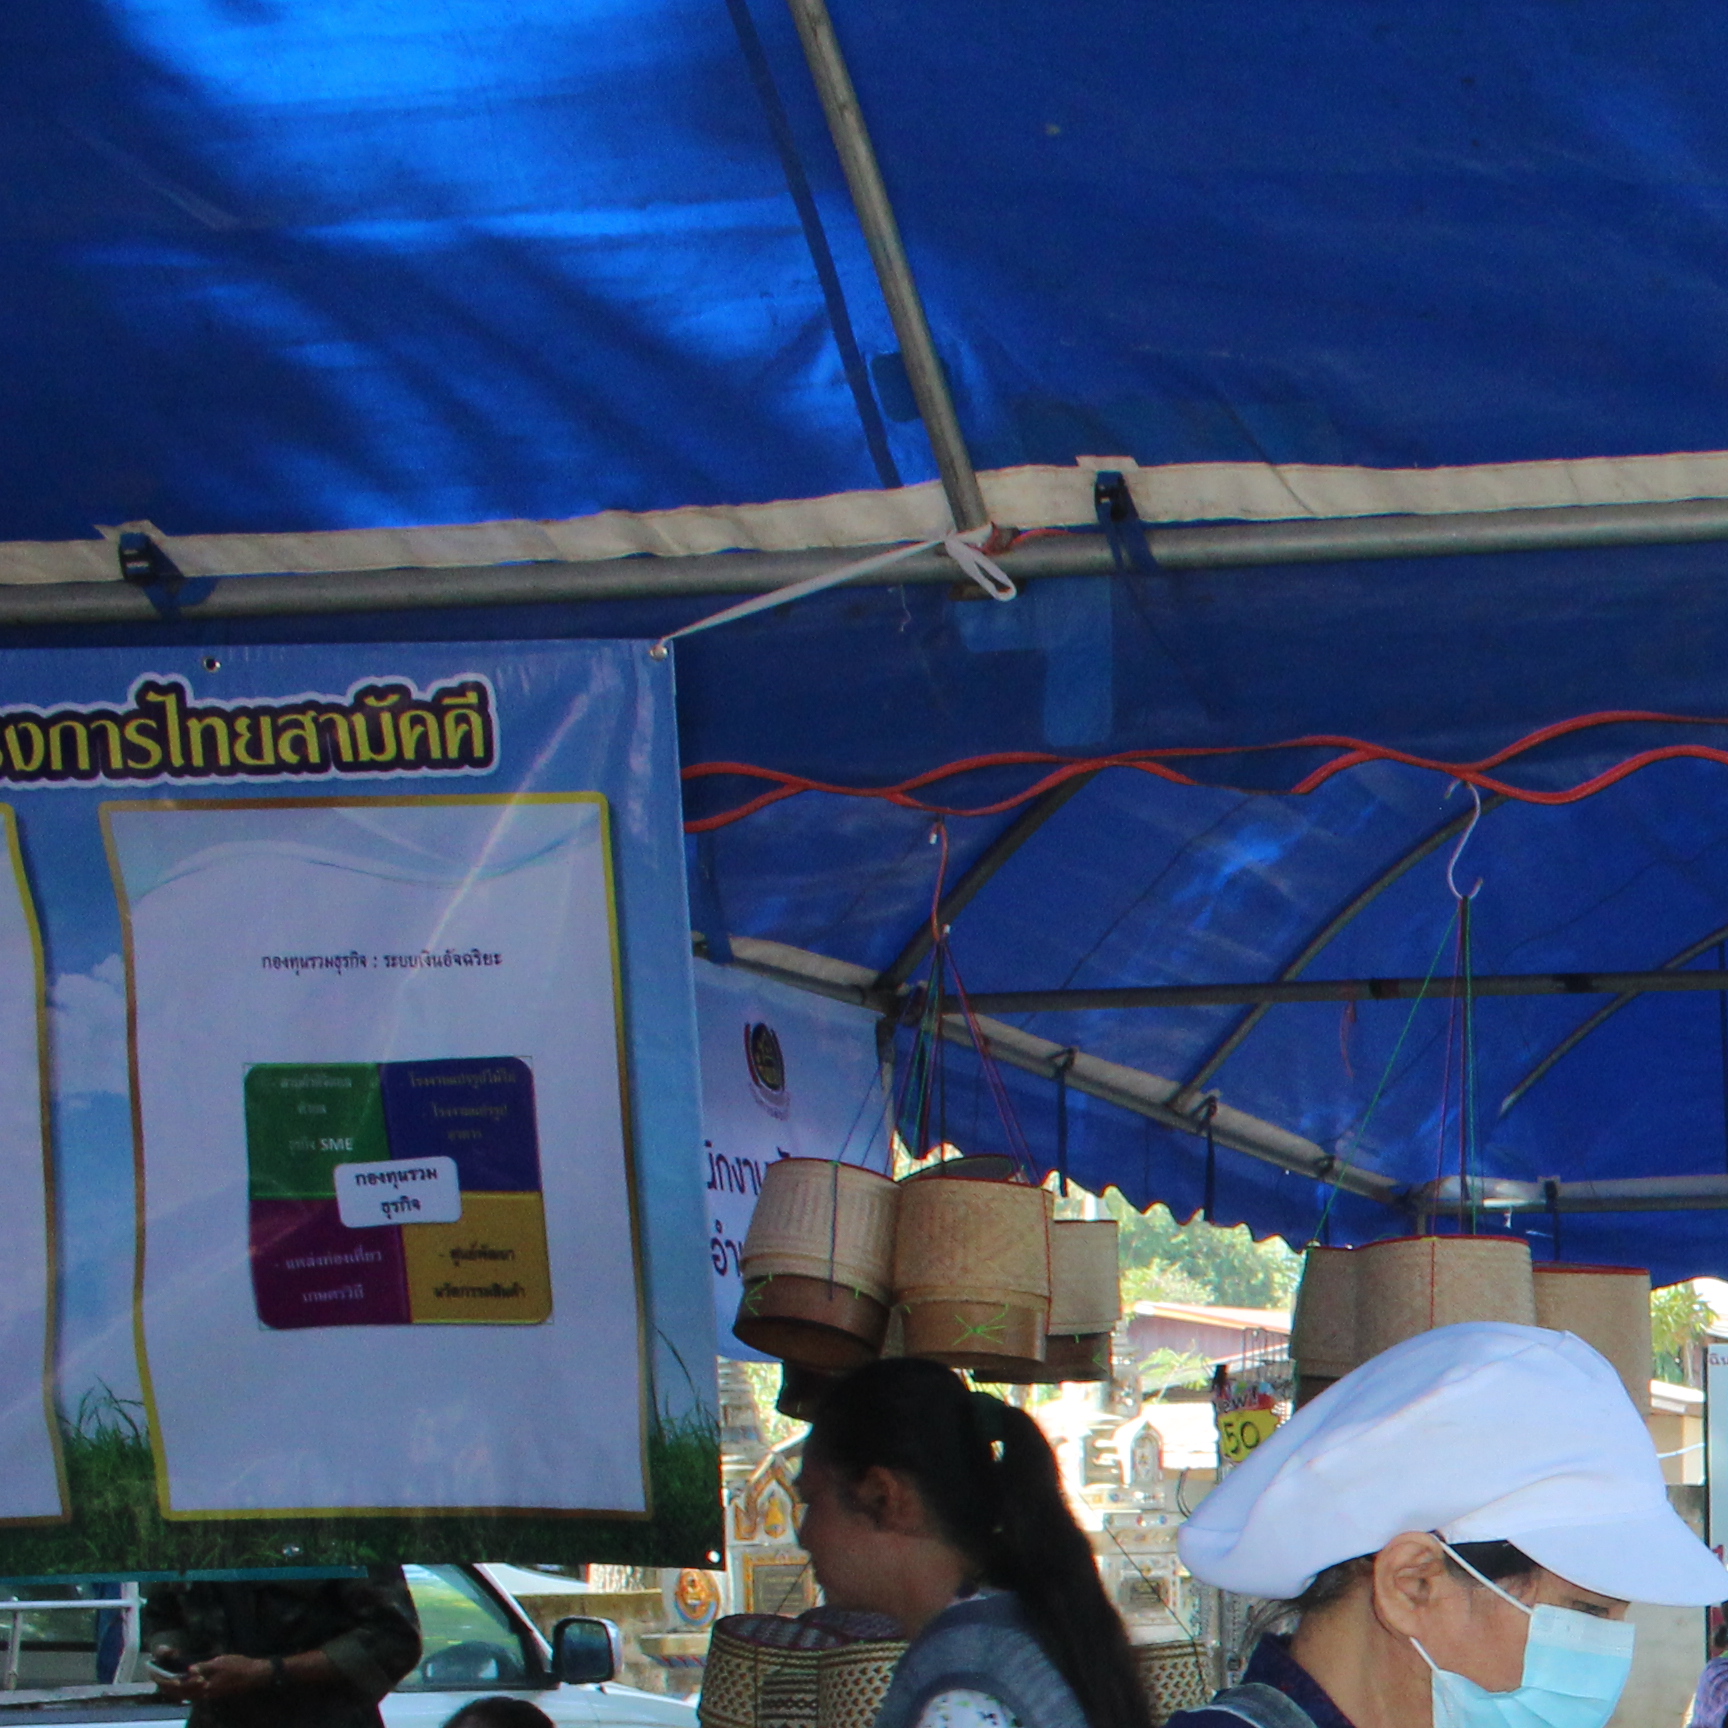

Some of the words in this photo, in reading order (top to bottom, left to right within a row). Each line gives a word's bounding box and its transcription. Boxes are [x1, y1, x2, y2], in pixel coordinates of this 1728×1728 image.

[0, 690, 487, 772] งการไทยสามัคคี
[320, 1137, 354, 1151] SME
[355, 1167, 438, 1189] กองทุนรวม
[381, 1196, 421, 1219] ธุรกิจ
